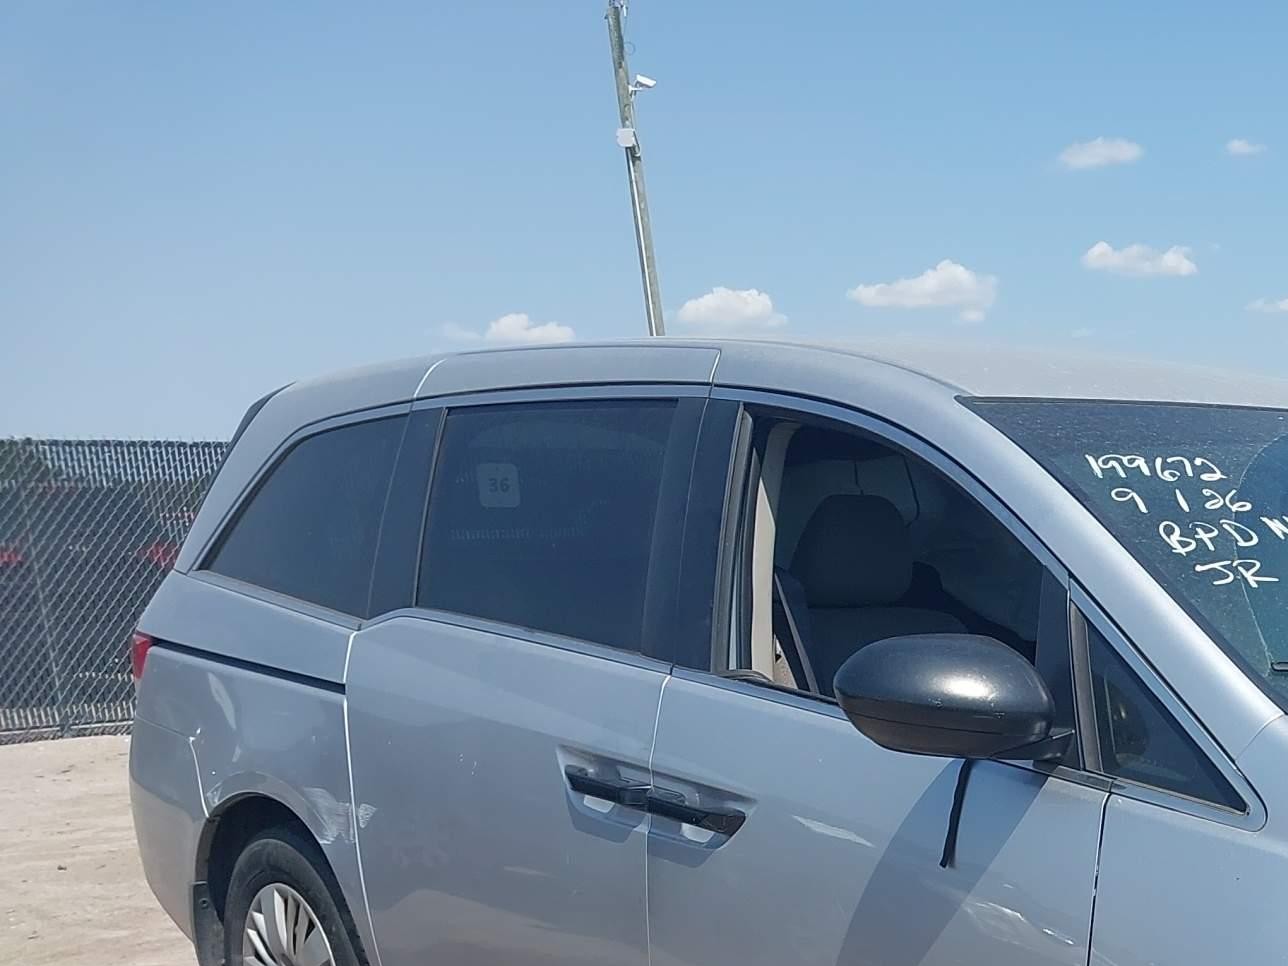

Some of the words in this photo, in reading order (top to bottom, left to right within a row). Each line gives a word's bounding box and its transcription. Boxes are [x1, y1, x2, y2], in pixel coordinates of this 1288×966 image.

[488, 477, 511, 493] 36
[1110, 487, 1148, 514] 9
[1158, 518, 1259, 557] BPD
[1194, 558, 1280, 588] JR
